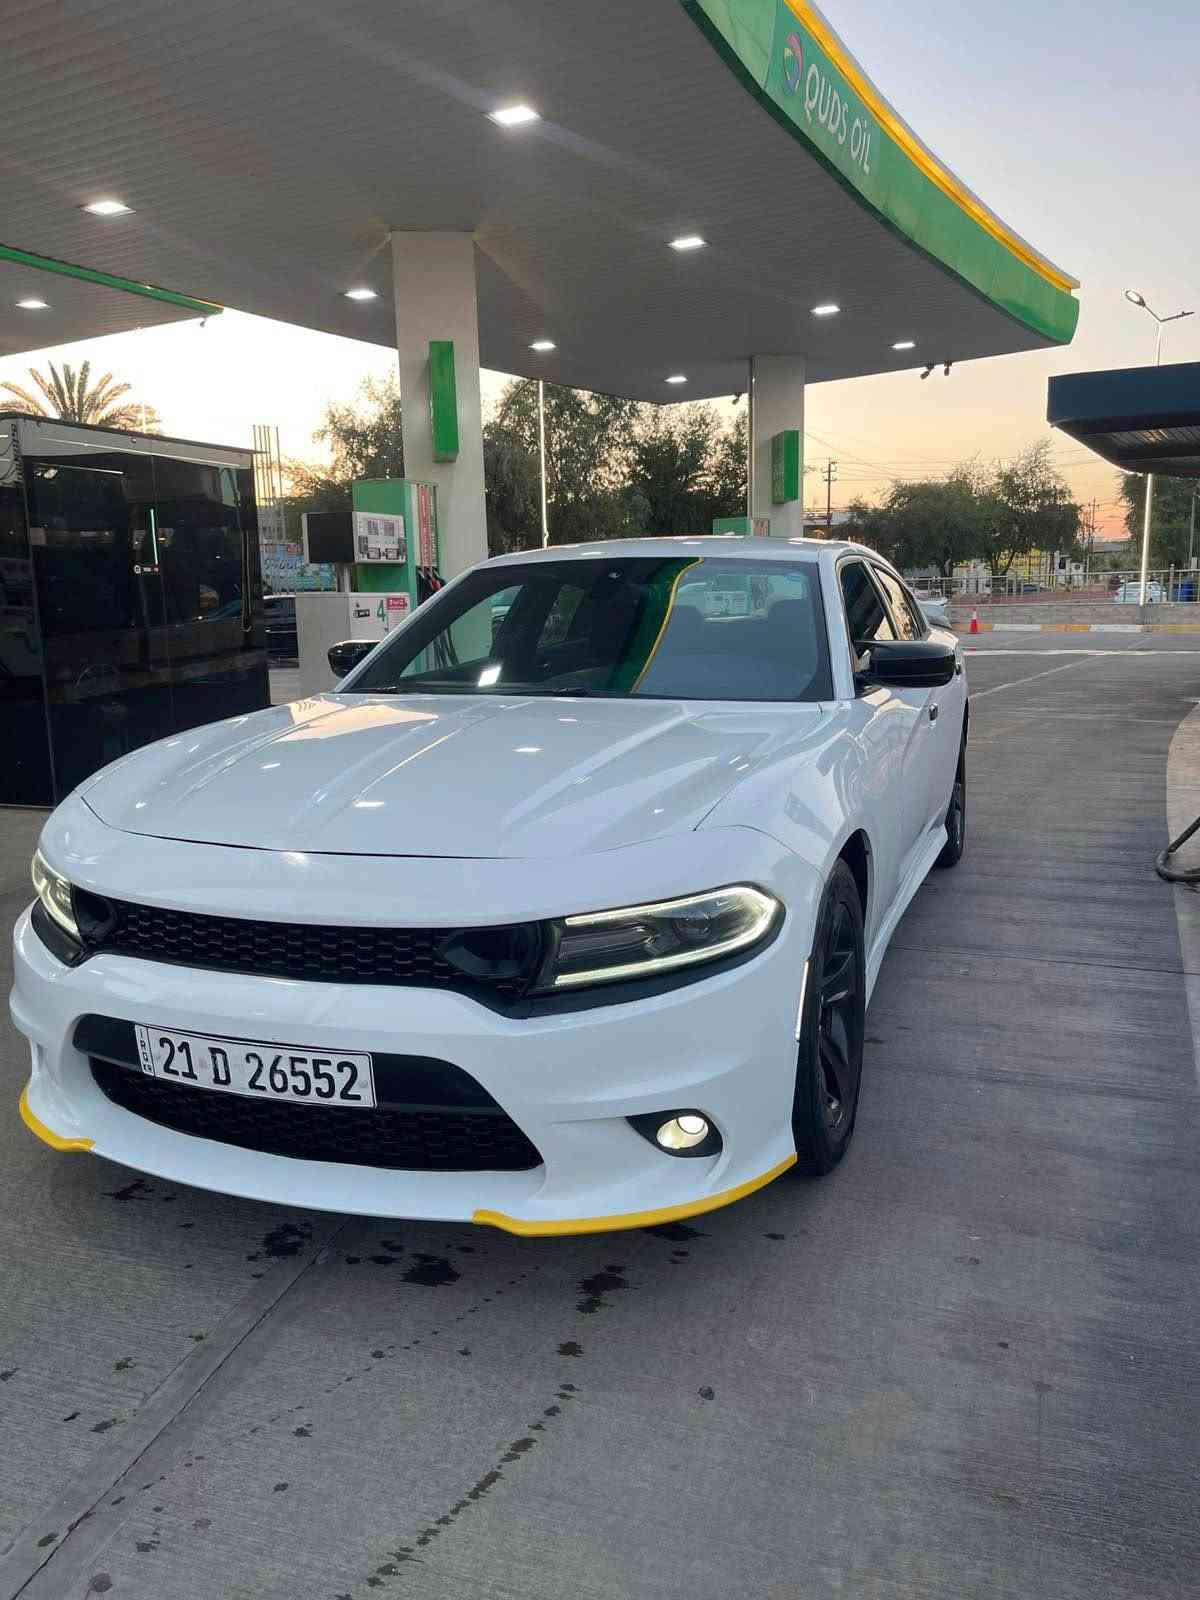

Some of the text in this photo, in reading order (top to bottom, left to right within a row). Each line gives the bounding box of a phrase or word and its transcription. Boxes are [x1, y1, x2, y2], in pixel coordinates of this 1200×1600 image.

[805, 64, 849, 145] QUDS
[376, 599, 386, 622] 4
[159, 1037, 362, 1101] 21 D 26552
